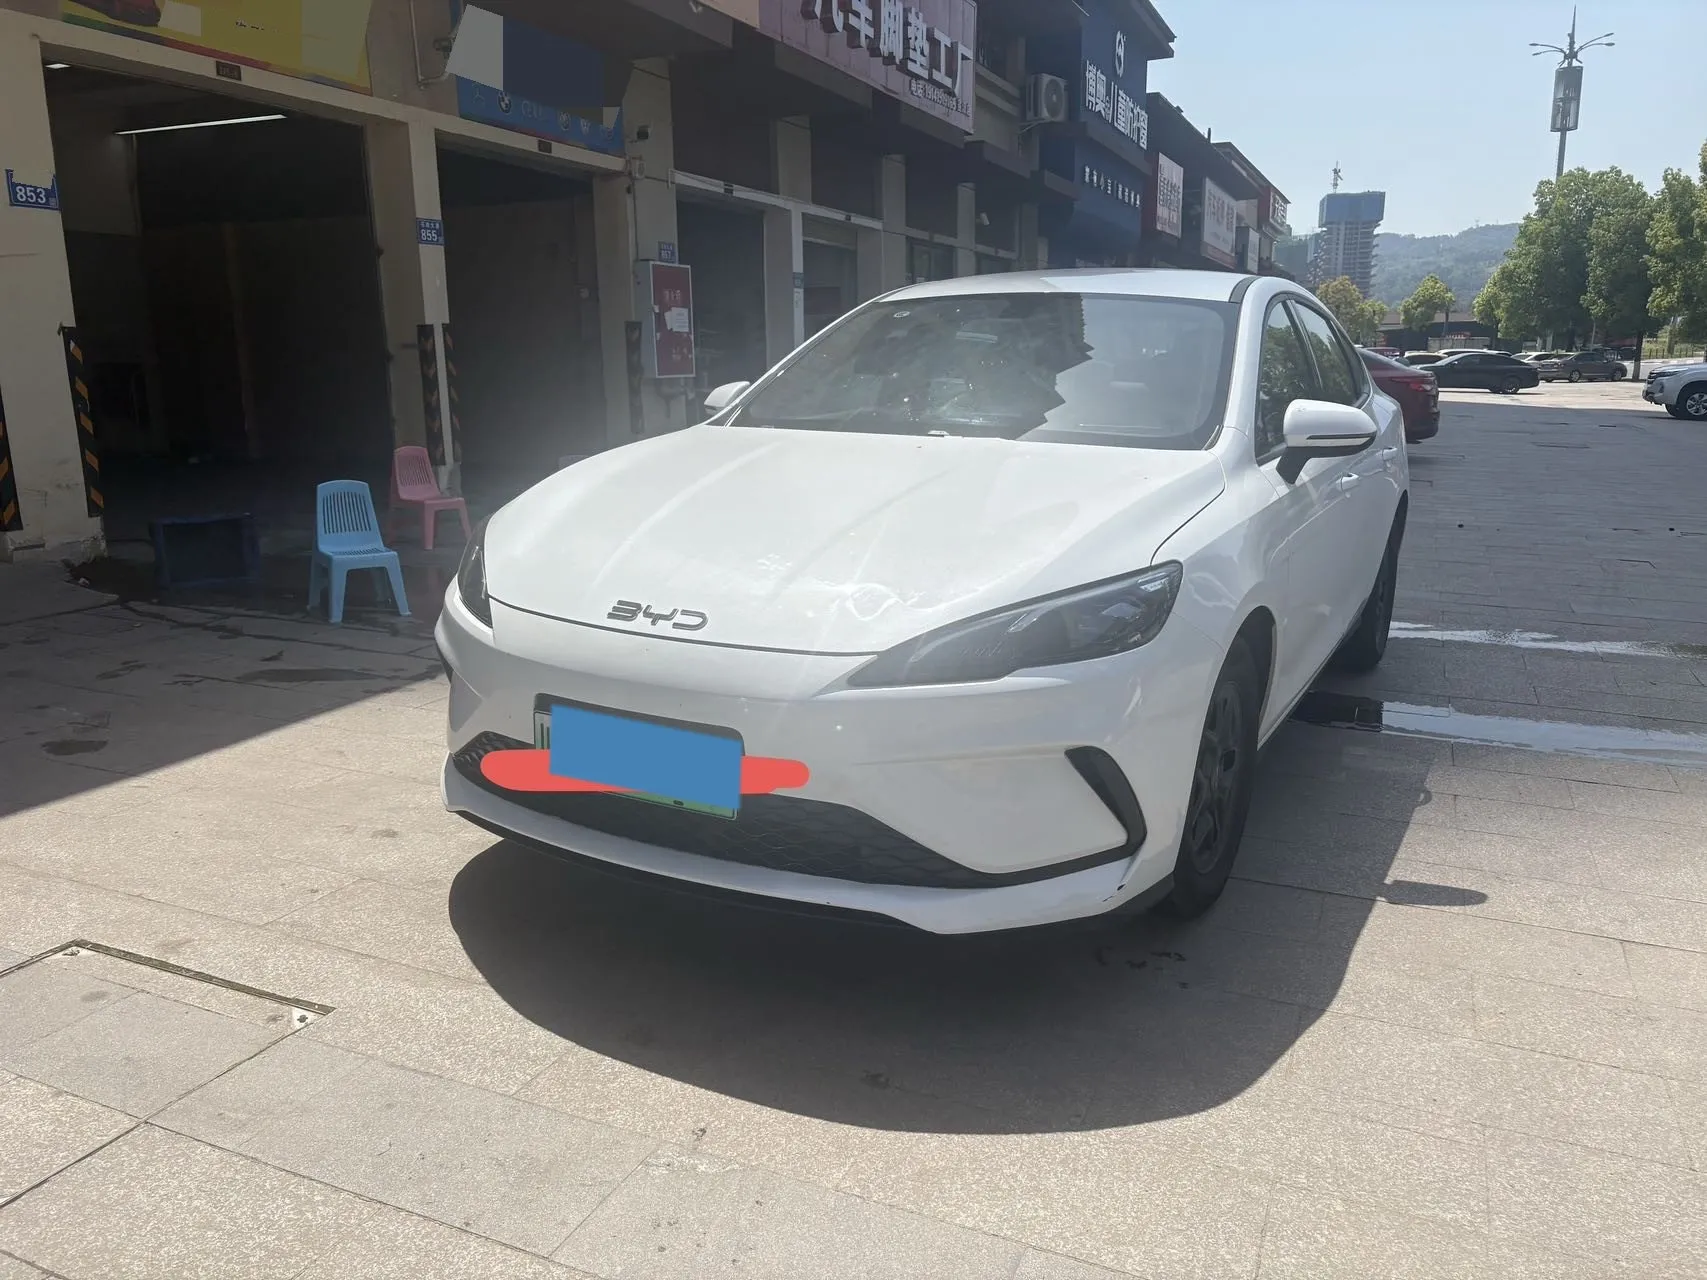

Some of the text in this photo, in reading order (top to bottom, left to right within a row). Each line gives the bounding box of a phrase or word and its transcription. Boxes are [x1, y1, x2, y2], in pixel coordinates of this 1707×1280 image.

[16, 185, 47, 203] 853
[421, 229, 437, 241] 855
[606, 599, 709, 631] BYD
